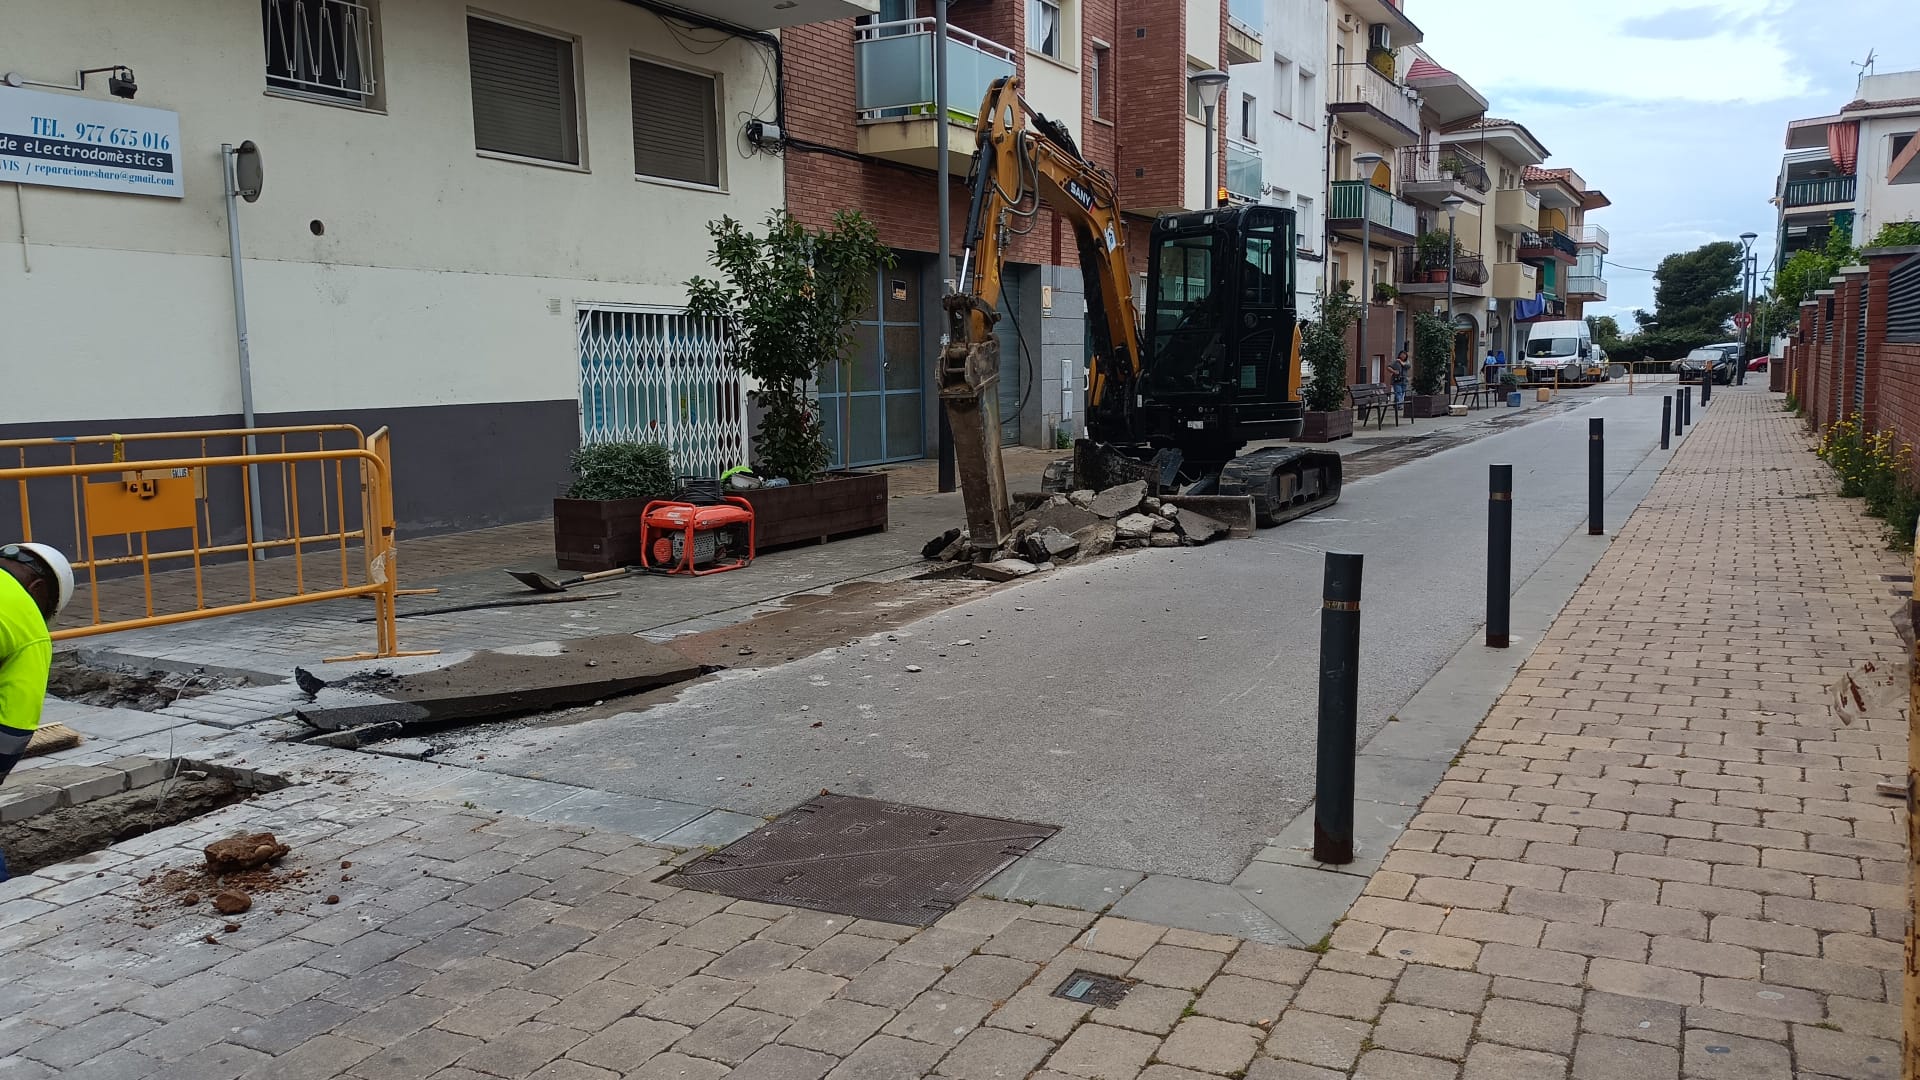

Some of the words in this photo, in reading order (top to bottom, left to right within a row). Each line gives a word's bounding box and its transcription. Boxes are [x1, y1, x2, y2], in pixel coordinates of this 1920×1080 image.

[31, 116, 65, 138] TEL.
[76, 122, 105, 142] 977
[110, 128, 137, 147] 675
[143, 132, 170, 150] 016
[0, 136, 17, 150] de
[24, 140, 164, 167] electrodomèstics
[35, 164, 174, 186] reparacionesharo@gmail.com
[1070, 181, 1091, 206] SANY
